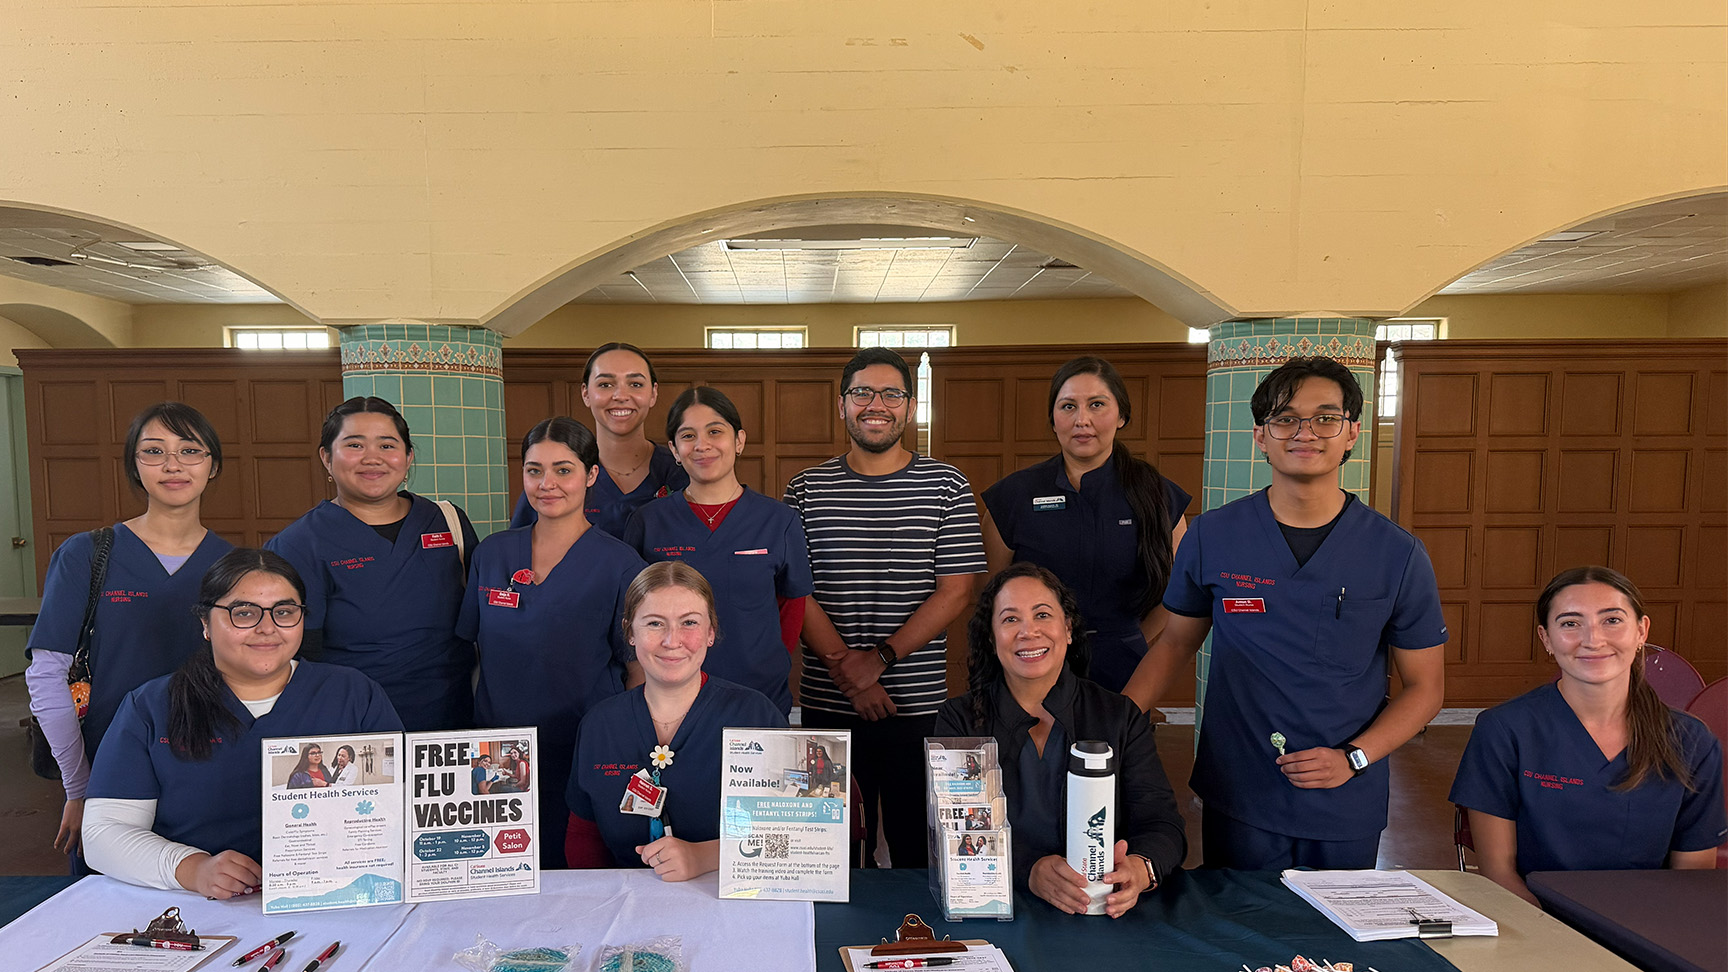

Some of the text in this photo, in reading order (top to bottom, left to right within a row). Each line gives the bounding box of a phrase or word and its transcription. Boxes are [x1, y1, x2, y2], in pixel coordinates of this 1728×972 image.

[1231, 574, 1252, 582] CHANNEL
[1254, 577, 1276, 586] ISLANDS
[1236, 581, 1256, 590] NURSING
[415, 742, 470, 768] FREE
[729, 765, 753, 773] Now
[729, 779, 780, 788] Available!
[1523, 770, 1584, 786] CSU CHANNEL ISLANDS
[415, 772, 455, 798] FLU
[1541, 781, 1563, 790] NURSING
[272, 788, 379, 801] Student Health Services
[414, 798, 523, 828] VACCINES
[939, 808, 964, 819] FREE
[504, 832, 521, 840] Petit
[1088, 845, 1096, 882] Channel
